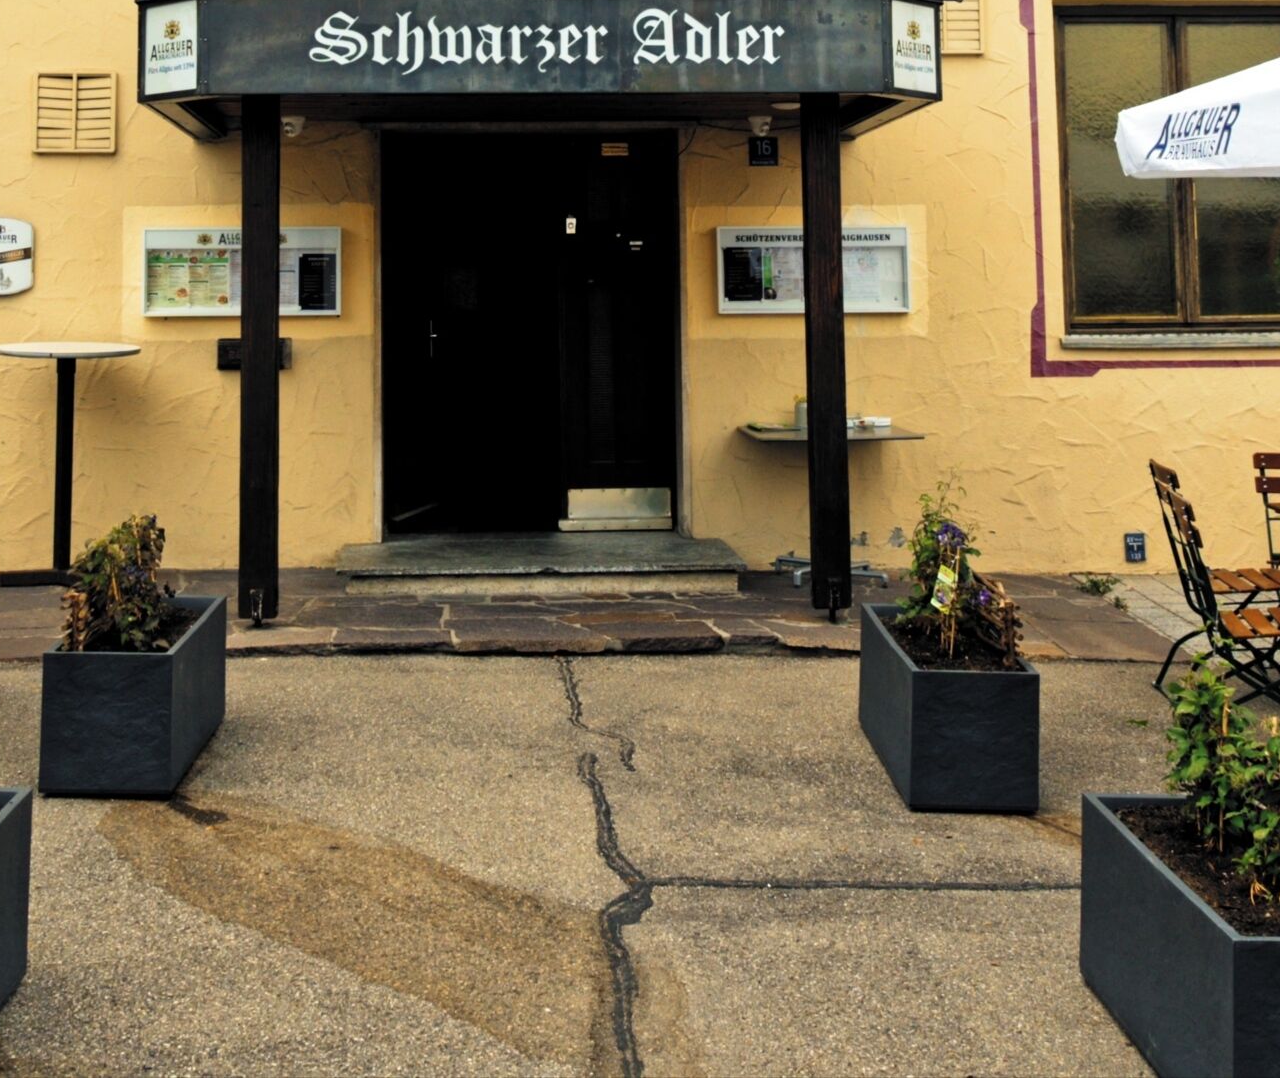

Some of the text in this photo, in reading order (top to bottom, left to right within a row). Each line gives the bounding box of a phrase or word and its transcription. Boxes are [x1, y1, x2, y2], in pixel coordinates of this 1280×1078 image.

[308, 7, 785, 75] Schwarzer Adler
[756, 139, 772, 155] 16
[1144, 102, 1241, 161] ALLGÄUER
[735, 233, 891, 243] SCHÜTZENVERE AIGHAUSEN
